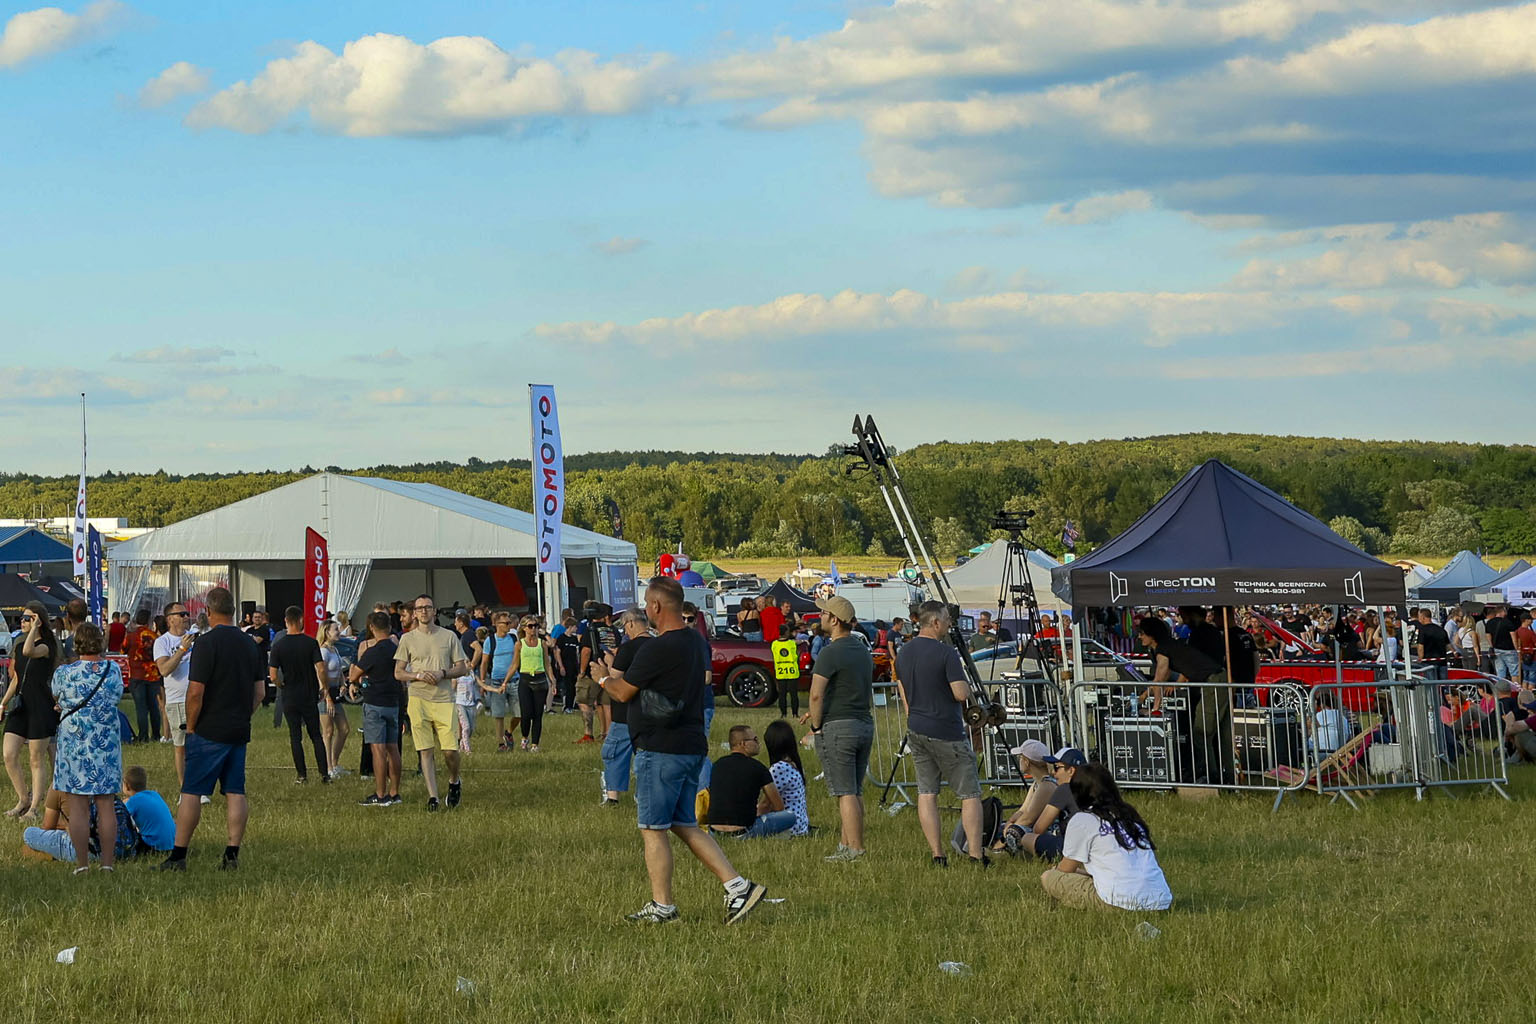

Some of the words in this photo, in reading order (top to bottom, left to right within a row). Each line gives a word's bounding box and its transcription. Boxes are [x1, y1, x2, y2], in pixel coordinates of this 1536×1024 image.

[538, 395, 558, 564] OTOMOTO
[1144, 577, 1216, 588] direcTON
[777, 667, 796, 675] 216
